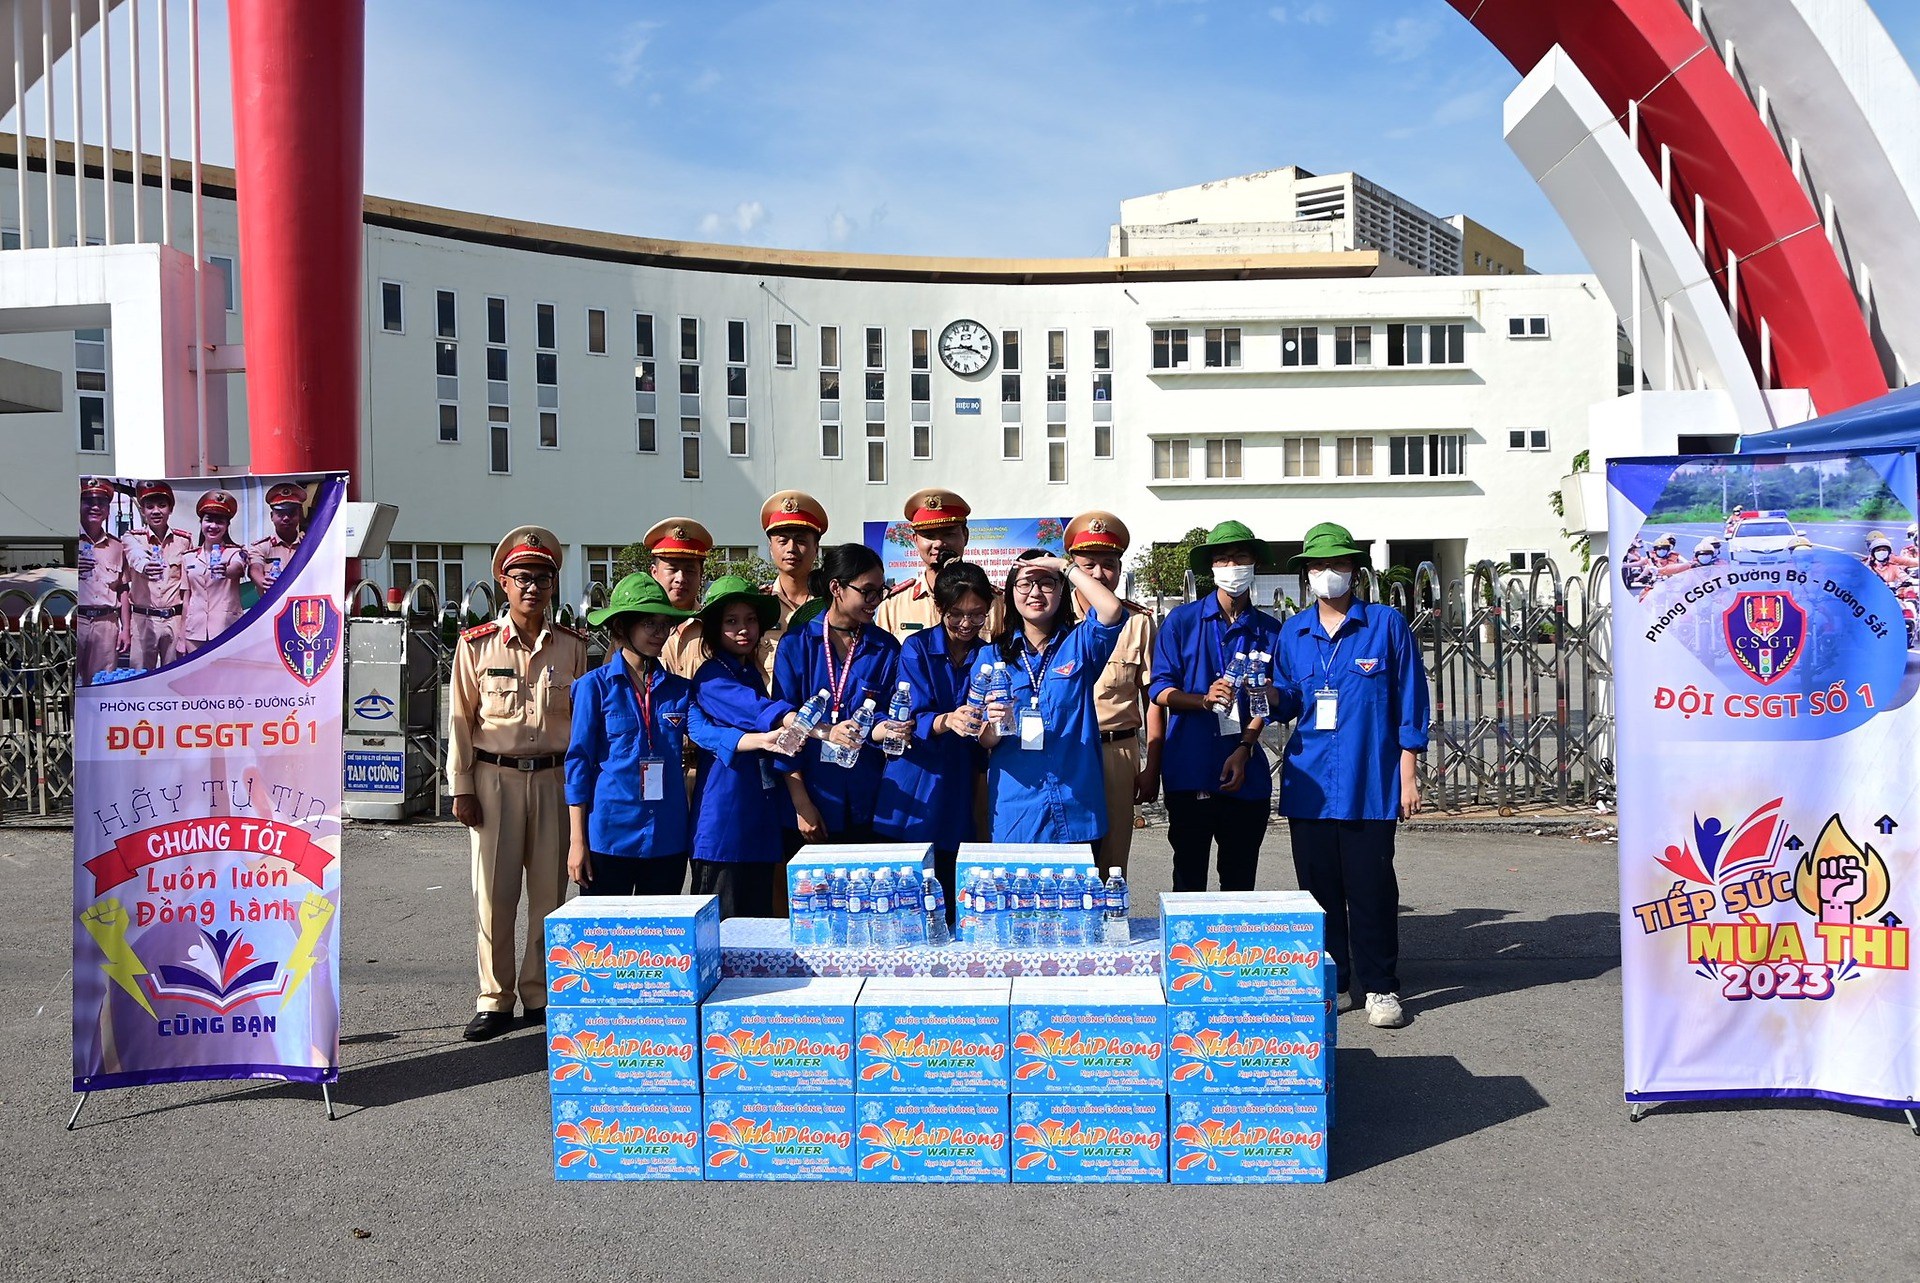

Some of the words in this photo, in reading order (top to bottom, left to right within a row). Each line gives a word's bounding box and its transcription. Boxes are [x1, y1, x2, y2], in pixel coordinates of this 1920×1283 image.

[1645, 603, 1687, 643] Phòng
[1684, 576, 1722, 604] CSGT
[1727, 568, 1781, 586] Đường
[1786, 569, 1808, 586] Bộ
[1822, 579, 1867, 619] Đường
[1864, 612, 1889, 640] Sắt
[285, 638, 332, 652] CSGT
[1736, 636, 1794, 648] CSGT
[100, 700, 146, 712] PHÒNG
[149, 701, 180, 712] CSGT
[182, 698, 226, 711] ĐƯỜNG
[229, 696, 245, 711] BỘ
[256, 695, 296, 708] ĐƯỜNG
[299, 692, 317, 707] SẮT
[1654, 684, 1714, 720] ĐỘI
[1724, 694, 1802, 718] CSGT
[1808, 680, 1849, 716] SỐ
[1856, 684, 1875, 708] 1
[107, 720, 164, 756] ĐỘI
[176, 722, 254, 748] CSGT
[262, 710, 302, 745] SỐ
[308, 718, 318, 744] 1
[347, 765, 366, 782] TAM
[368, 761, 400, 782] CƯỜNG
[94, 784, 182, 836] HÃY
[201, 778, 253, 810] TỰ
[272, 784, 326, 829] TIN
[147, 822, 230, 858] CHÚNG
[241, 821, 286, 856] TÔI
[146, 866, 216, 893] Luôn
[232, 861, 288, 890] luôn
[1633, 880, 1716, 934] TIẾP
[1722, 870, 1795, 914] SỨC
[136, 897, 215, 927] Đồng
[230, 899, 296, 922] hành
[663, 927, 685, 935] CHAI
[1290, 923, 1313, 932] CHAI
[1687, 913, 1808, 964] MÙA
[1815, 922, 1910, 970] THI
[615, 969, 663, 978] WATER
[1239, 966, 1289, 976] WATER
[1722, 963, 1835, 1001] 2023
[665, 1017, 687, 1025] CHAI
[822, 1016, 844, 1024] CHAI
[976, 1016, 999, 1024] CHAI
[1134, 1015, 1156, 1023] CHAI
[1292, 1014, 1314, 1023] CHAI
[232, 1016, 277, 1038] BẠN
[617, 1058, 665, 1068] WATER
[773, 1057, 821, 1066] WATER
[927, 1058, 976, 1067] WATER
[1083, 1057, 1132, 1066] WATER
[1240, 1057, 1290, 1067] WATER
[669, 1105, 691, 1113] CHAI
[823, 1105, 845, 1113] CHAI
[976, 1106, 998, 1114] CHAI
[1133, 1105, 1156, 1113] CHAI
[1294, 1105, 1316, 1113] CHAI
[622, 1145, 670, 1154] WATER
[774, 1145, 822, 1154] WATER
[927, 1147, 975, 1156] WATER
[1083, 1146, 1132, 1156] WATER
[1243, 1146, 1293, 1156] WATER
